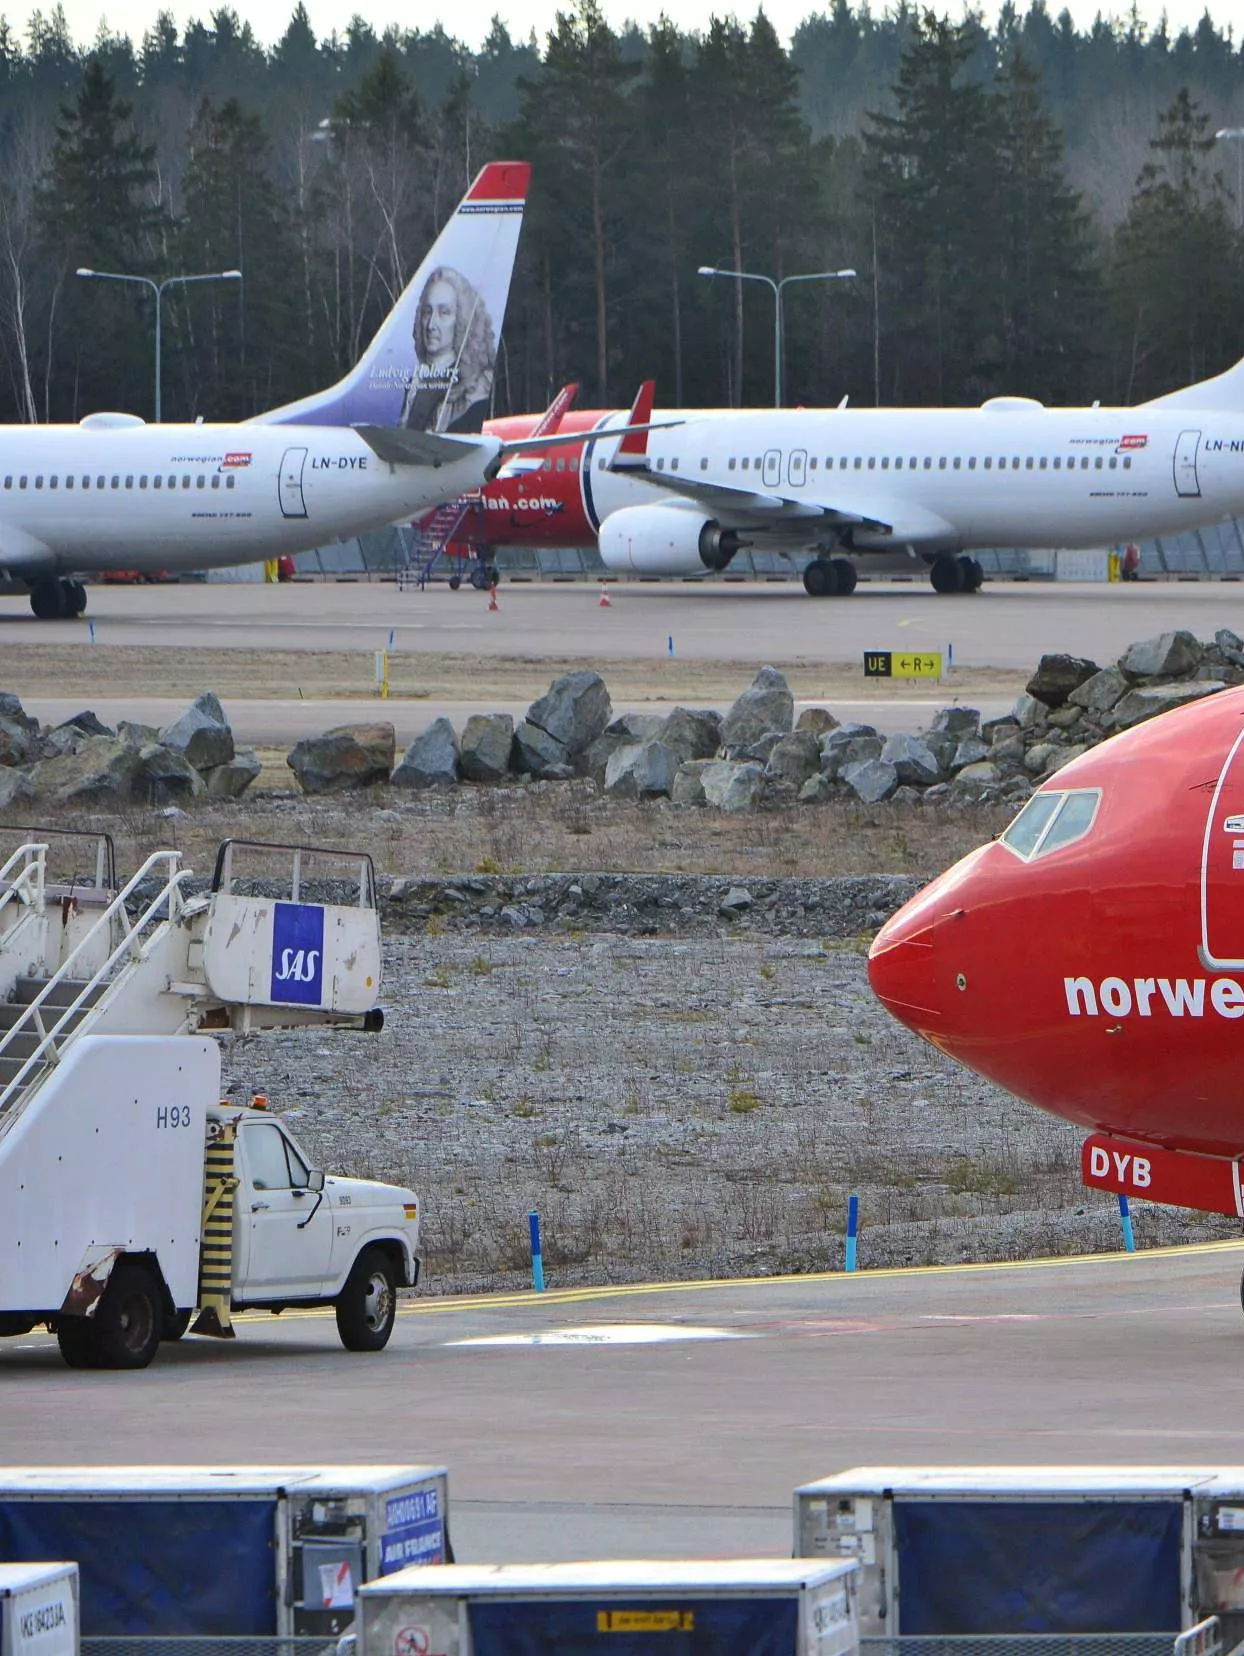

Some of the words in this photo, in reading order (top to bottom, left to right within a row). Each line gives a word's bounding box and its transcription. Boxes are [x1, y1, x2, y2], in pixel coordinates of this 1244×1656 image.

[370, 366, 409, 382] Ludvig
[413, 364, 459, 382] Holberg
[312, 457, 367, 469] LN-DYE
[868, 657, 886, 672] UE
[913, 657, 922, 672] R
[275, 948, 320, 982] SAS
[157, 1105, 191, 1129] H93
[1091, 1146, 1152, 1188] DYB
[385, 1542, 404, 1563] AIR
[404, 1531, 441, 1557] FRANCE
